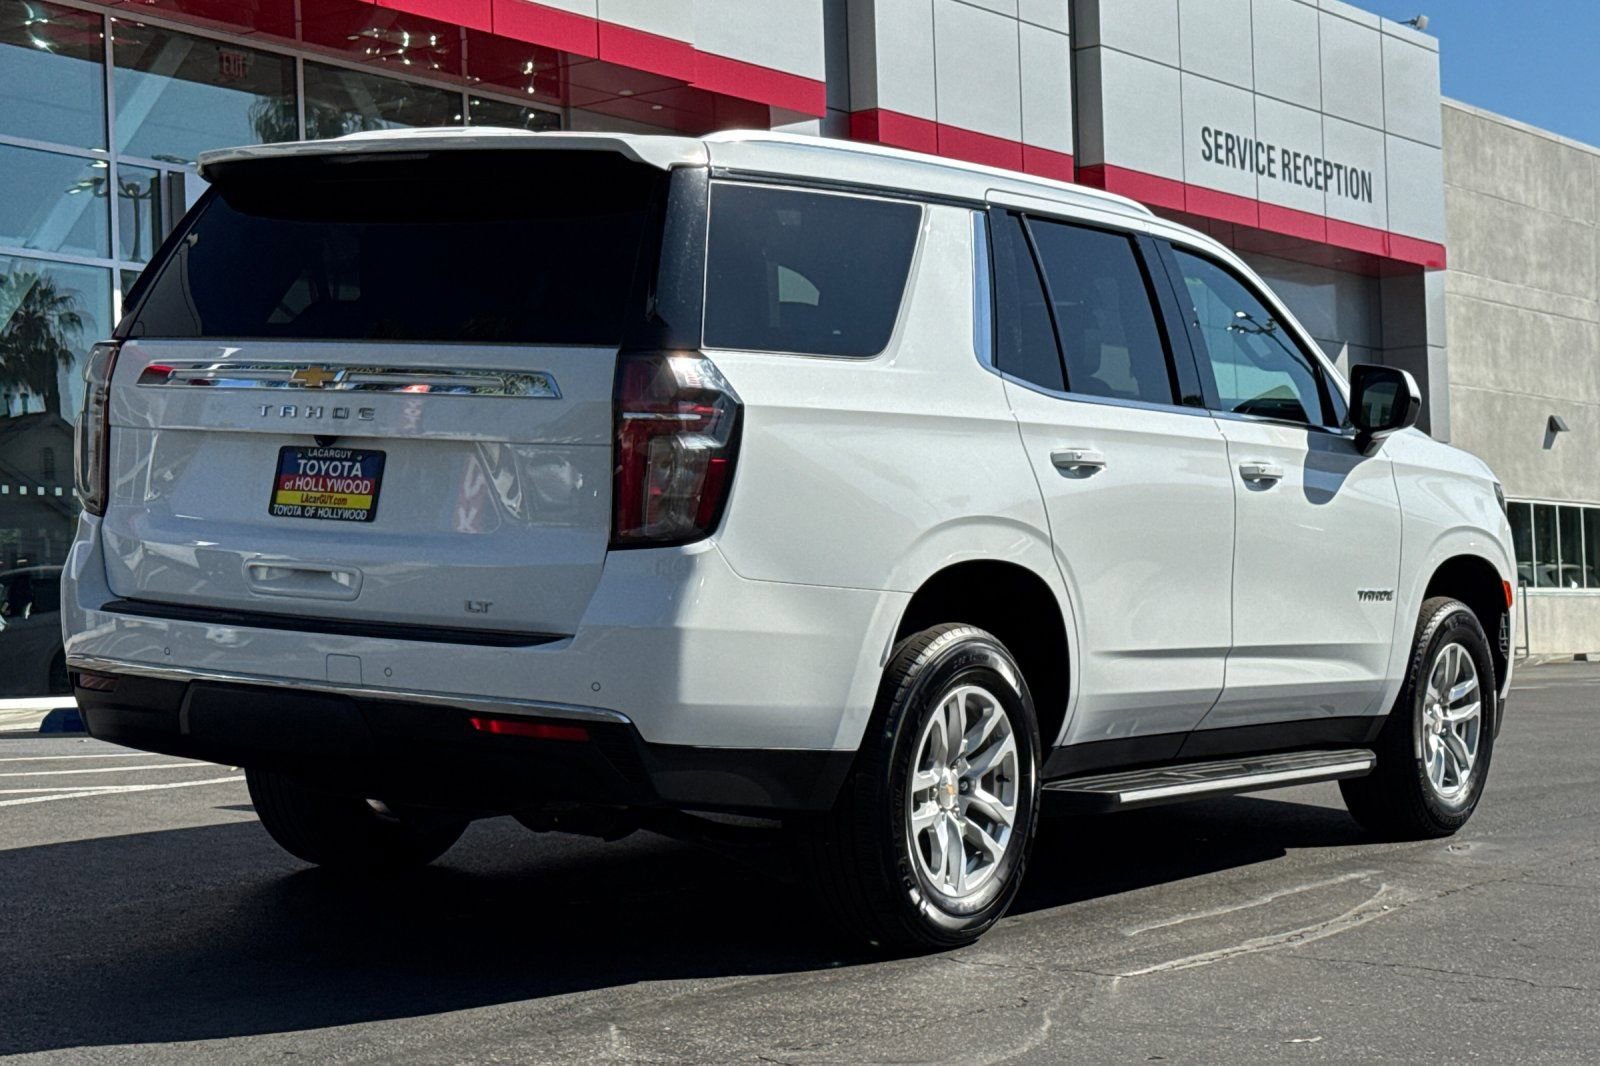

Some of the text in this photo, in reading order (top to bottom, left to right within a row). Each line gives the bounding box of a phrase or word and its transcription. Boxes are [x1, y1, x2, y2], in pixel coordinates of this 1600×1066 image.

[1201, 126, 1372, 203] SERVICE RECEPTION
[259, 404, 375, 420] TAHOE
[308, 448, 352, 458] LACARGUY
[297, 459, 362, 477] TOYOTA
[284, 477, 371, 494] of HOLLYWOOD
[273, 504, 368, 520] TOYOTA OF HOLLYWOOD
[464, 600, 494, 614] LT
